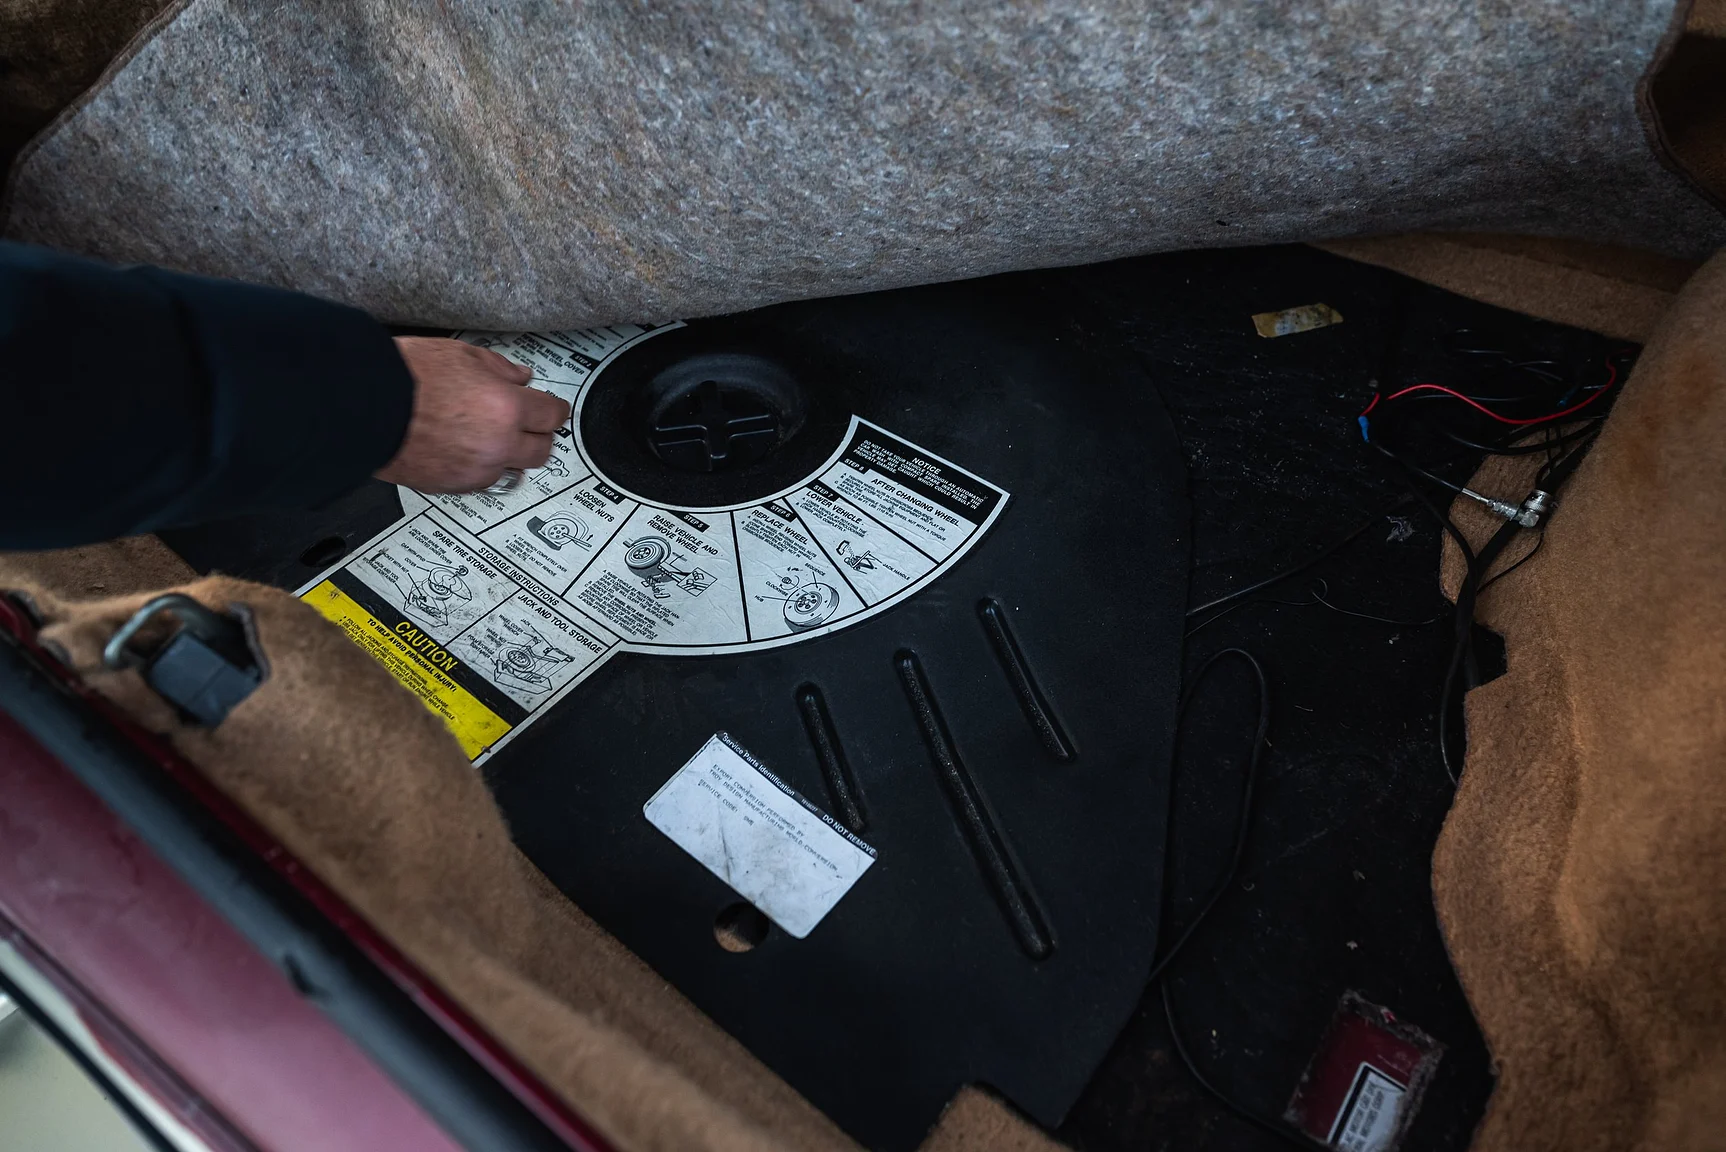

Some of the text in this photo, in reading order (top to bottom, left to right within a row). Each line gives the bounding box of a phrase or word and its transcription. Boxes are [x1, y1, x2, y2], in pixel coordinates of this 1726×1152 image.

[542, 347, 565, 362] WHEEL
[562, 360, 585, 375] COVER
[552, 441, 572, 454] JACK
[843, 457, 860, 468] STEP
[852, 448, 877, 463] PROPERTY
[911, 456, 942, 474] NOTICE
[598, 485, 615, 497] STEP
[812, 484, 829, 495] STEP
[855, 445, 877, 458] VEHICLE
[875, 455, 887, 463] MAY
[896, 466, 917, 478] CAUGHT
[916, 476, 934, 487] WHICH
[933, 485, 952, 496] COULD
[950, 493, 971, 506] RESULT
[859, 442, 981, 506] CAR WASH WITH COMPACT SPARE THE
[924, 470, 949, 485] THROUGH
[954, 486, 984, 503] AUTOMATIC
[572, 493, 615, 523] WHEEL NUTS
[578, 488, 607, 508] LOOSEN
[769, 503, 786, 515] STEP
[805, 489, 862, 524] LOWER VEHICLE
[870, 477, 962, 526] AFTER CHANGING WHEEL
[646, 519, 700, 553] REMOVE WHEEL
[652, 514, 720, 556] RAISE VEHICLE AND
[682, 514, 699, 525] STEP
[751, 508, 810, 545] REPLACE WHEEL
[431, 529, 498, 580] SPARE TIRE STORAGE
[477, 546, 560, 606] STORAGE INSTRUCTIONS
[516, 592, 602, 654] JACK AND TOOL STORAGE
[365, 618, 458, 692] TO HELP AVOID PERSONAL INJURY:
[392, 619, 458, 672] CAUTION
[720, 734, 796, 797] Service Parts Identification
[698, 778, 722, 799] SERVICE
[712, 763, 805, 838] EXPORT CONVERSION PERFORMED BY
[707, 769, 723, 782] TROY
[722, 780, 744, 799] DESIGN
[742, 798, 785, 831] MANUFACTURING
[784, 830, 804, 846] WORLD
[821, 813, 876, 856] DO NOT REMOVE
